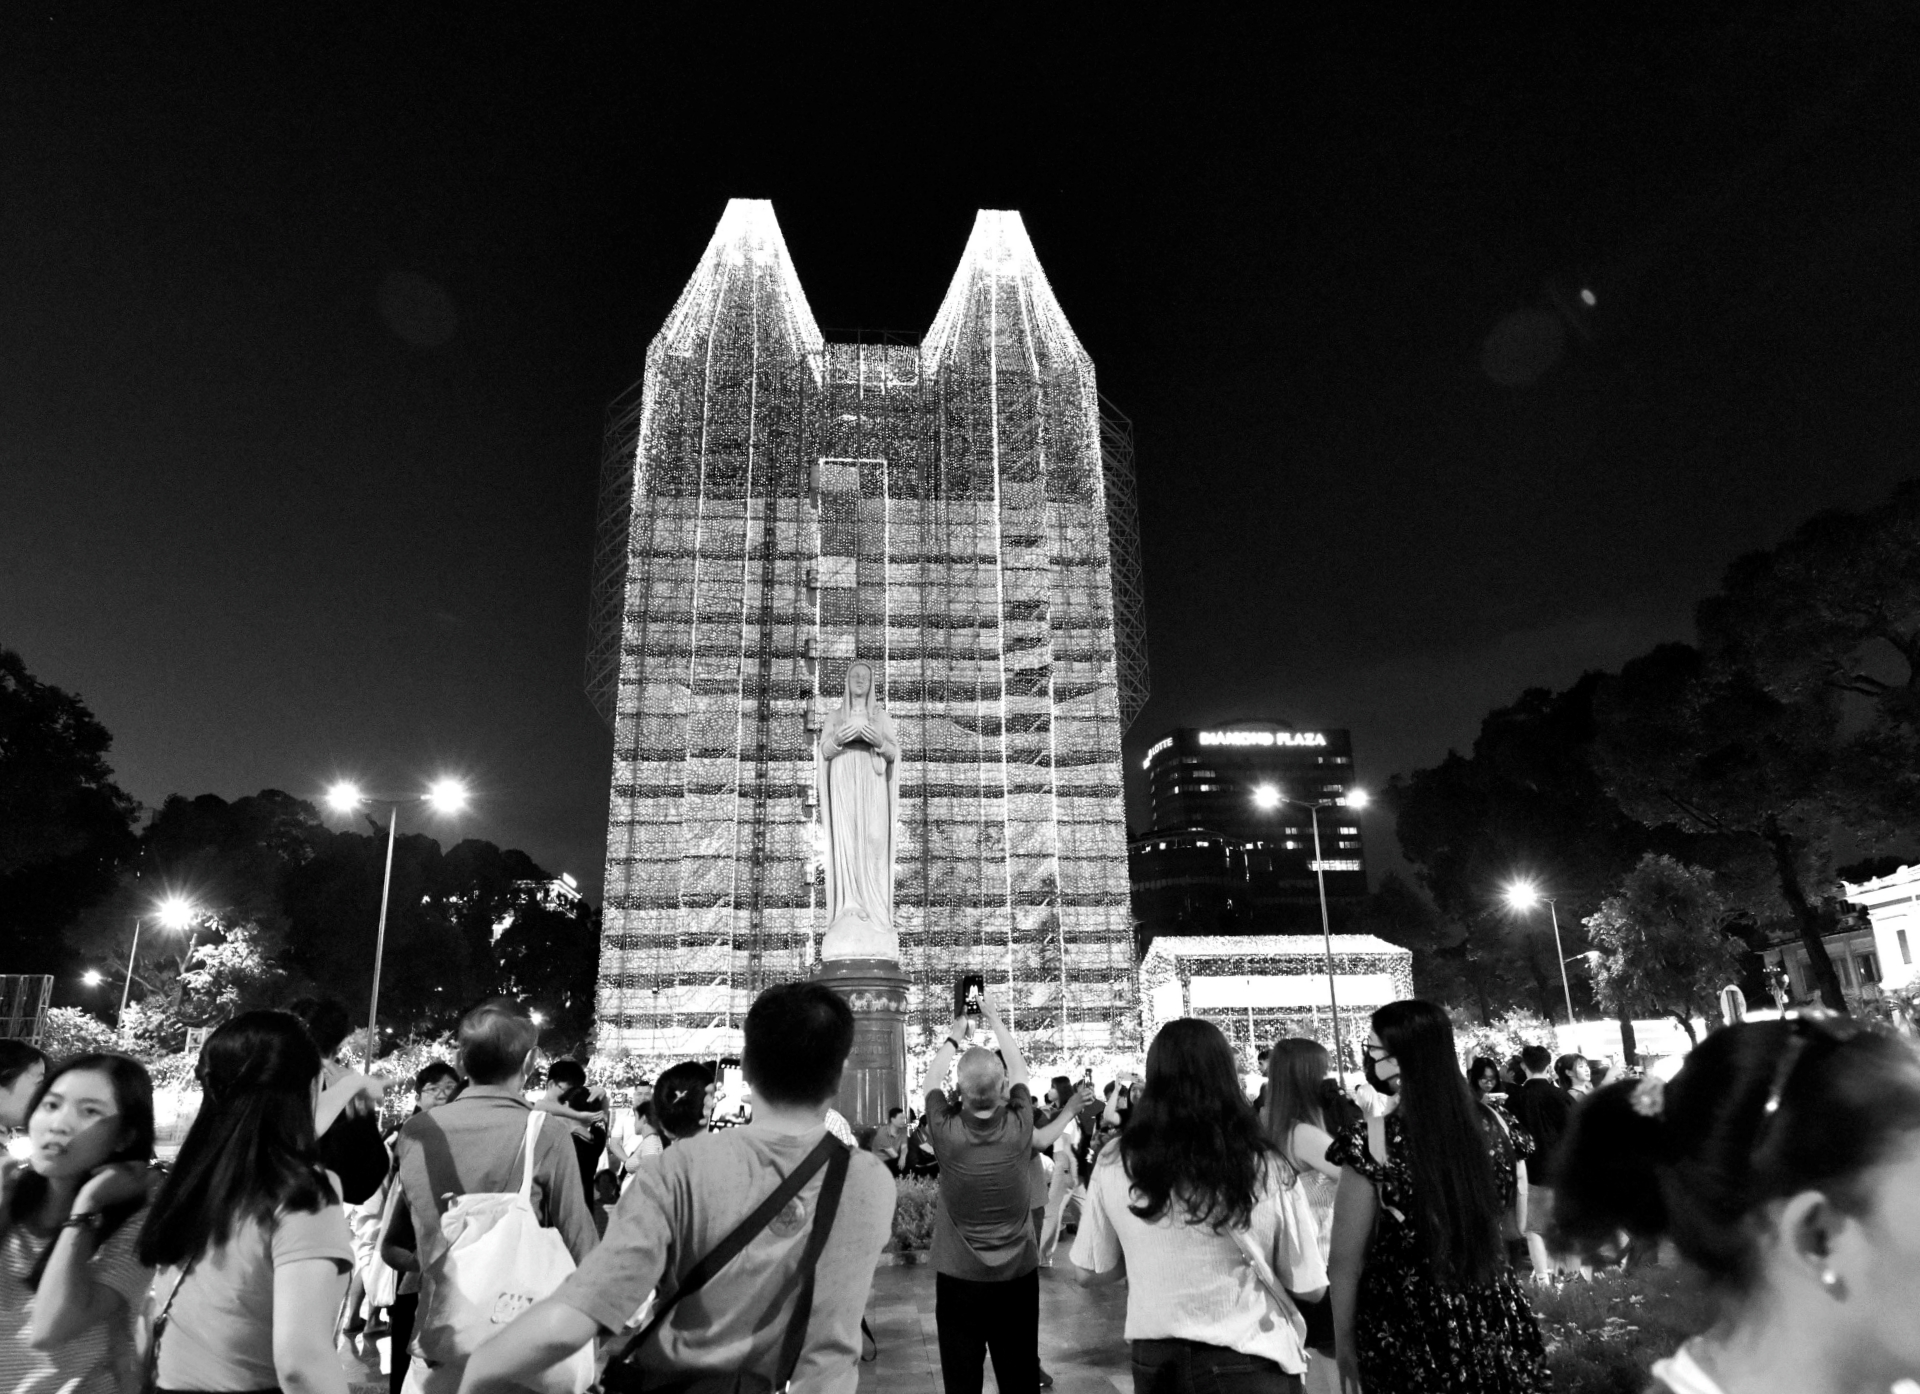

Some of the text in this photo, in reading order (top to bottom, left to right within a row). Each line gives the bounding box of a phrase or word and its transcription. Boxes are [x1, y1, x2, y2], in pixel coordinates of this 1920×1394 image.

[1151, 736, 1174, 756] LOTTE
[1198, 730, 1328, 747] DIAMOND PLAZA
